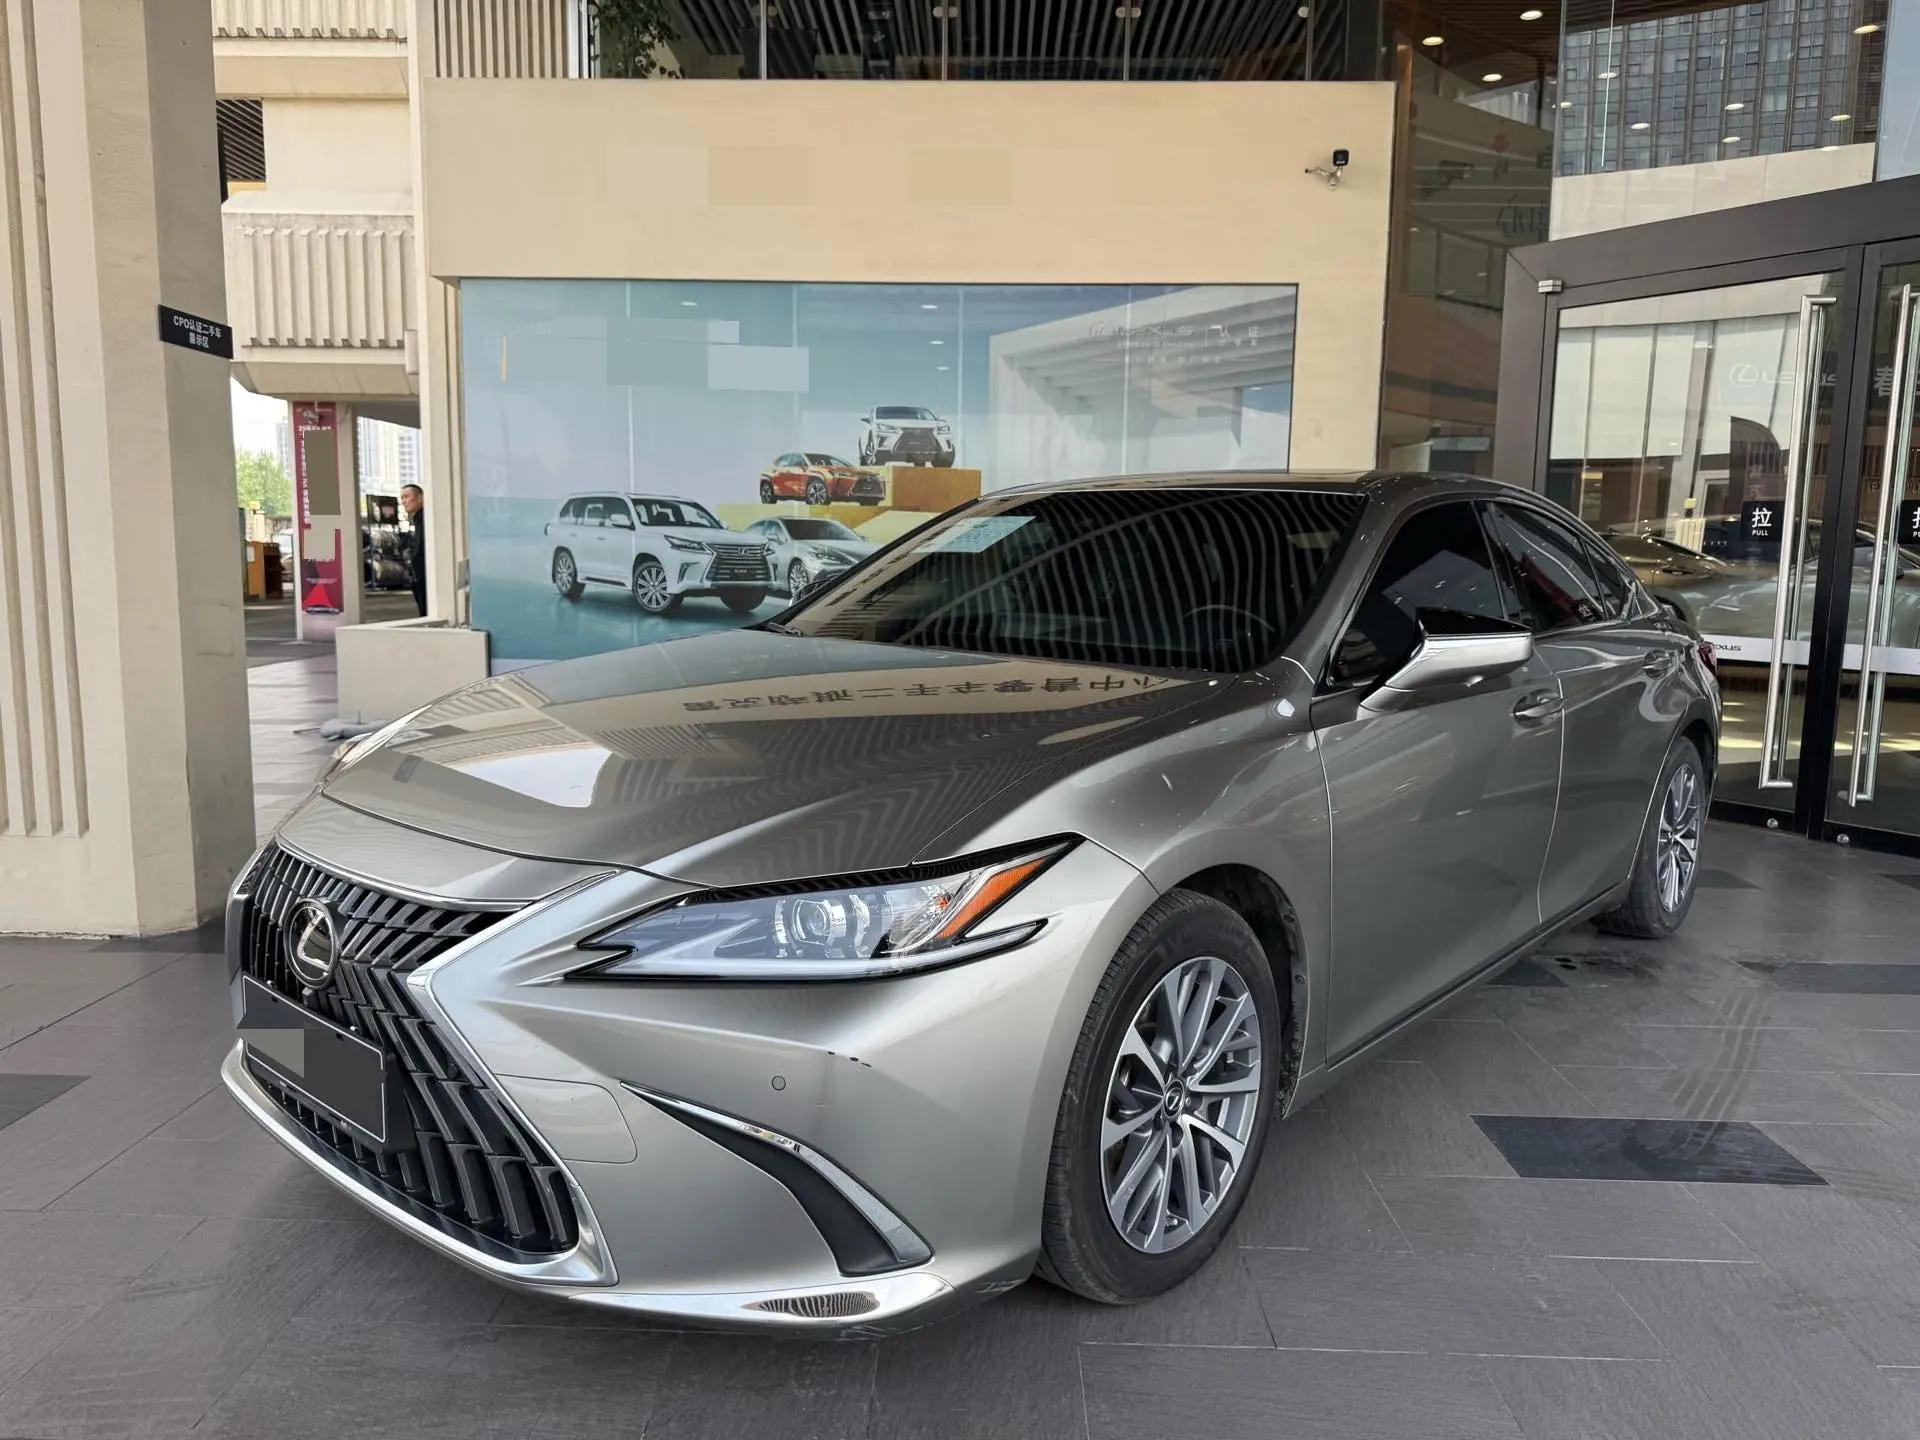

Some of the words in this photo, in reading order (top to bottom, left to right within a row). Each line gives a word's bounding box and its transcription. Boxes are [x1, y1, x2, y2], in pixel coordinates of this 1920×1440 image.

[173, 315, 222, 338] CPO认证二手车
[1751, 507, 1772, 528] 拉
